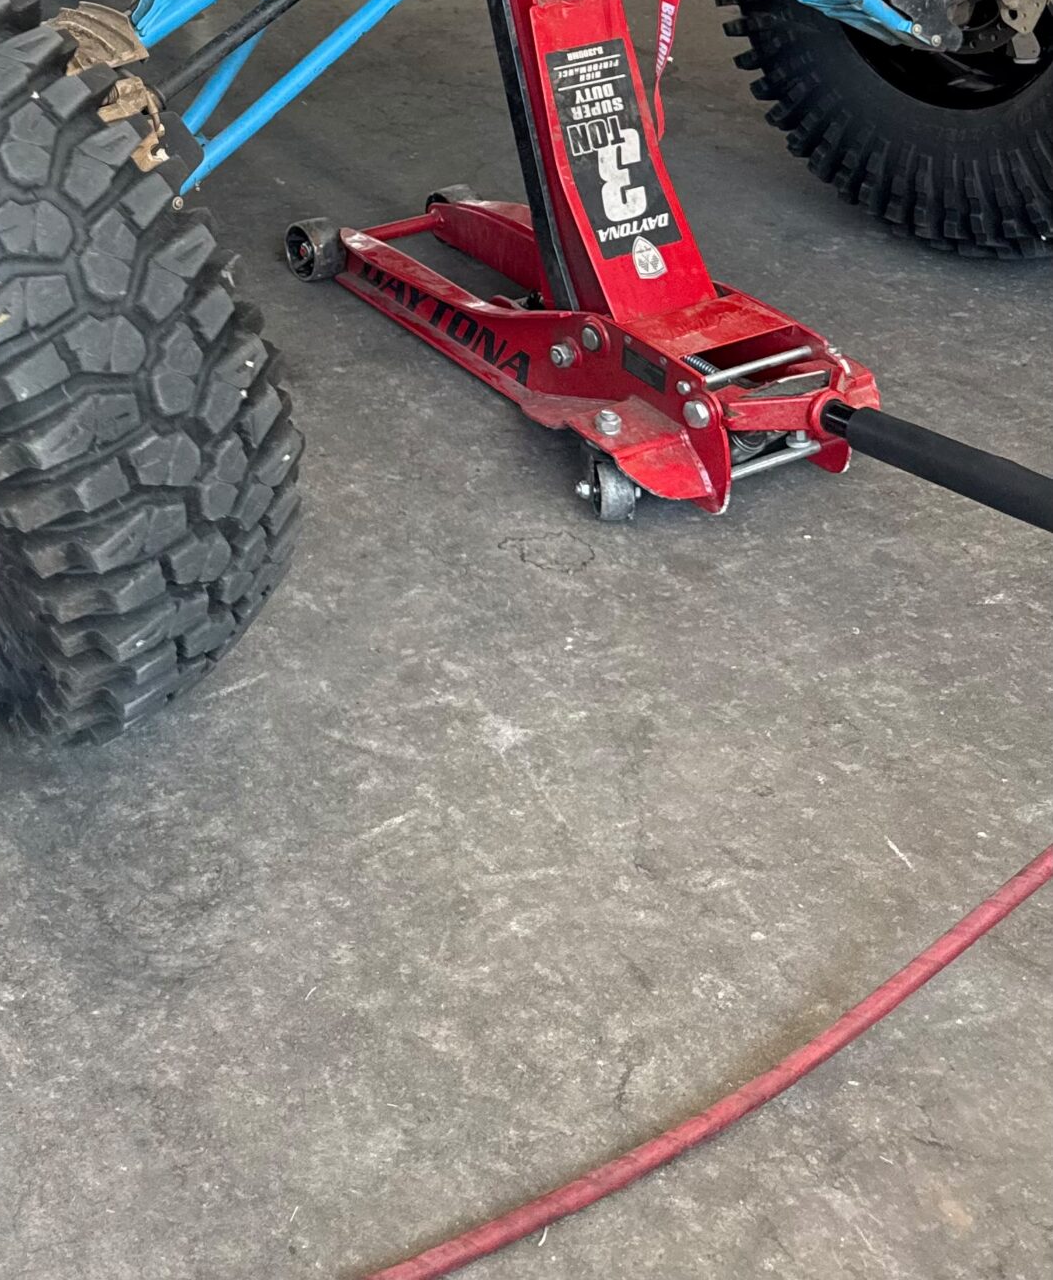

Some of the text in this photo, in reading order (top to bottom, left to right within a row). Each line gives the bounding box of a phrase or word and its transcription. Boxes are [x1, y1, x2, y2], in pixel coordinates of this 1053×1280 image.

[558, 58, 620, 79] PERFORMANCE
[571, 97, 625, 120] SUPER
[575, 83, 614, 105] DUTY
[567, 115, 625, 156] TON
[598, 128, 647, 222] 3
[597, 212, 669, 243] DAYTONA
[359, 262, 531, 385] DAYTONA
